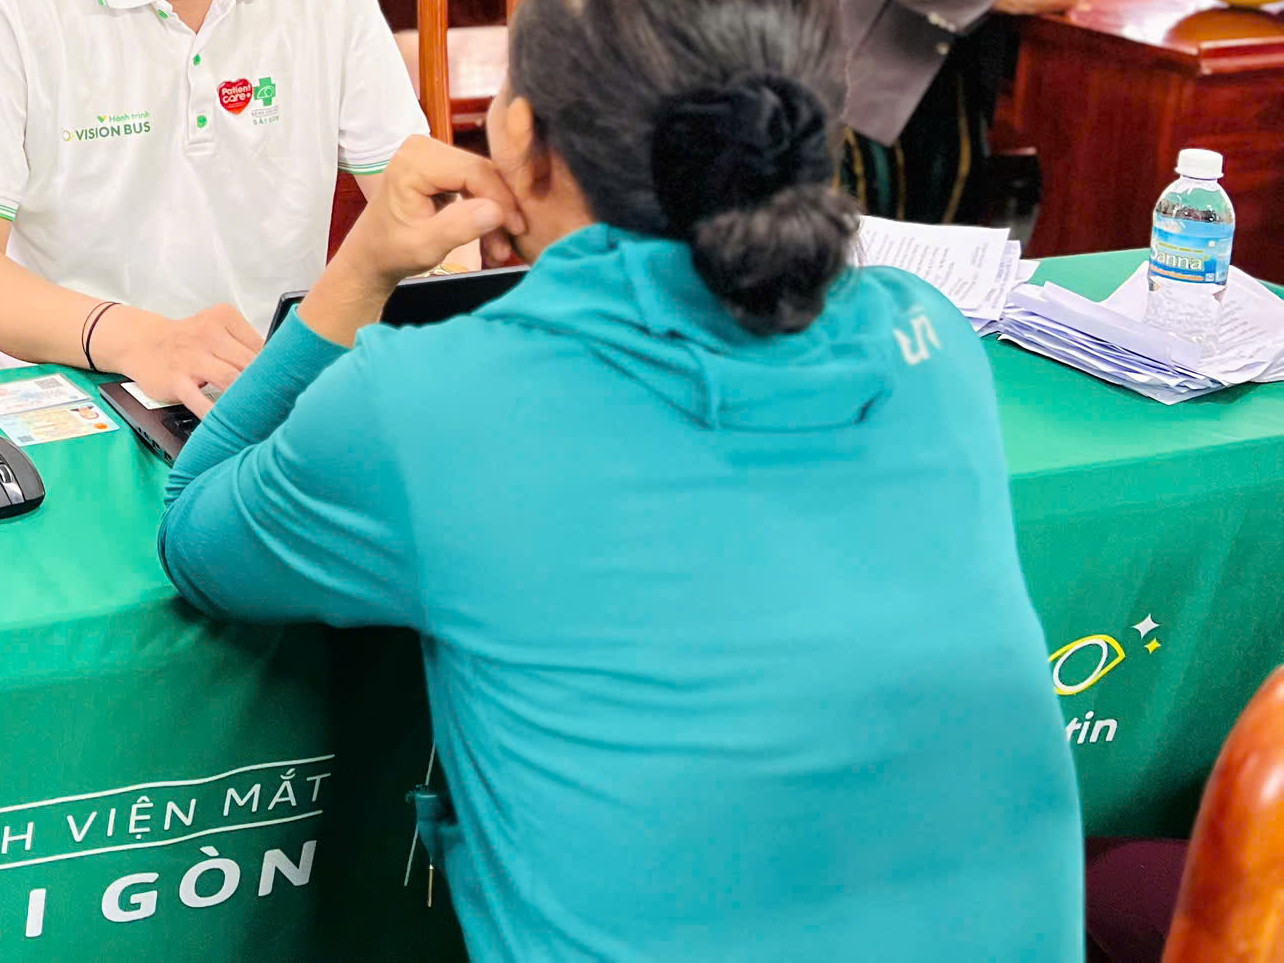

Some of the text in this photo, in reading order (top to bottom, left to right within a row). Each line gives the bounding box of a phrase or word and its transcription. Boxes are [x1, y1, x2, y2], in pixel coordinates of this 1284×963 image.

[221, 84, 251, 96] Patient
[75, 121, 151, 141] VISION BUS
[66, 795, 197, 843] VIỆN
[223, 768, 332, 817] MẮT
[101, 840, 317, 923] GÒN
